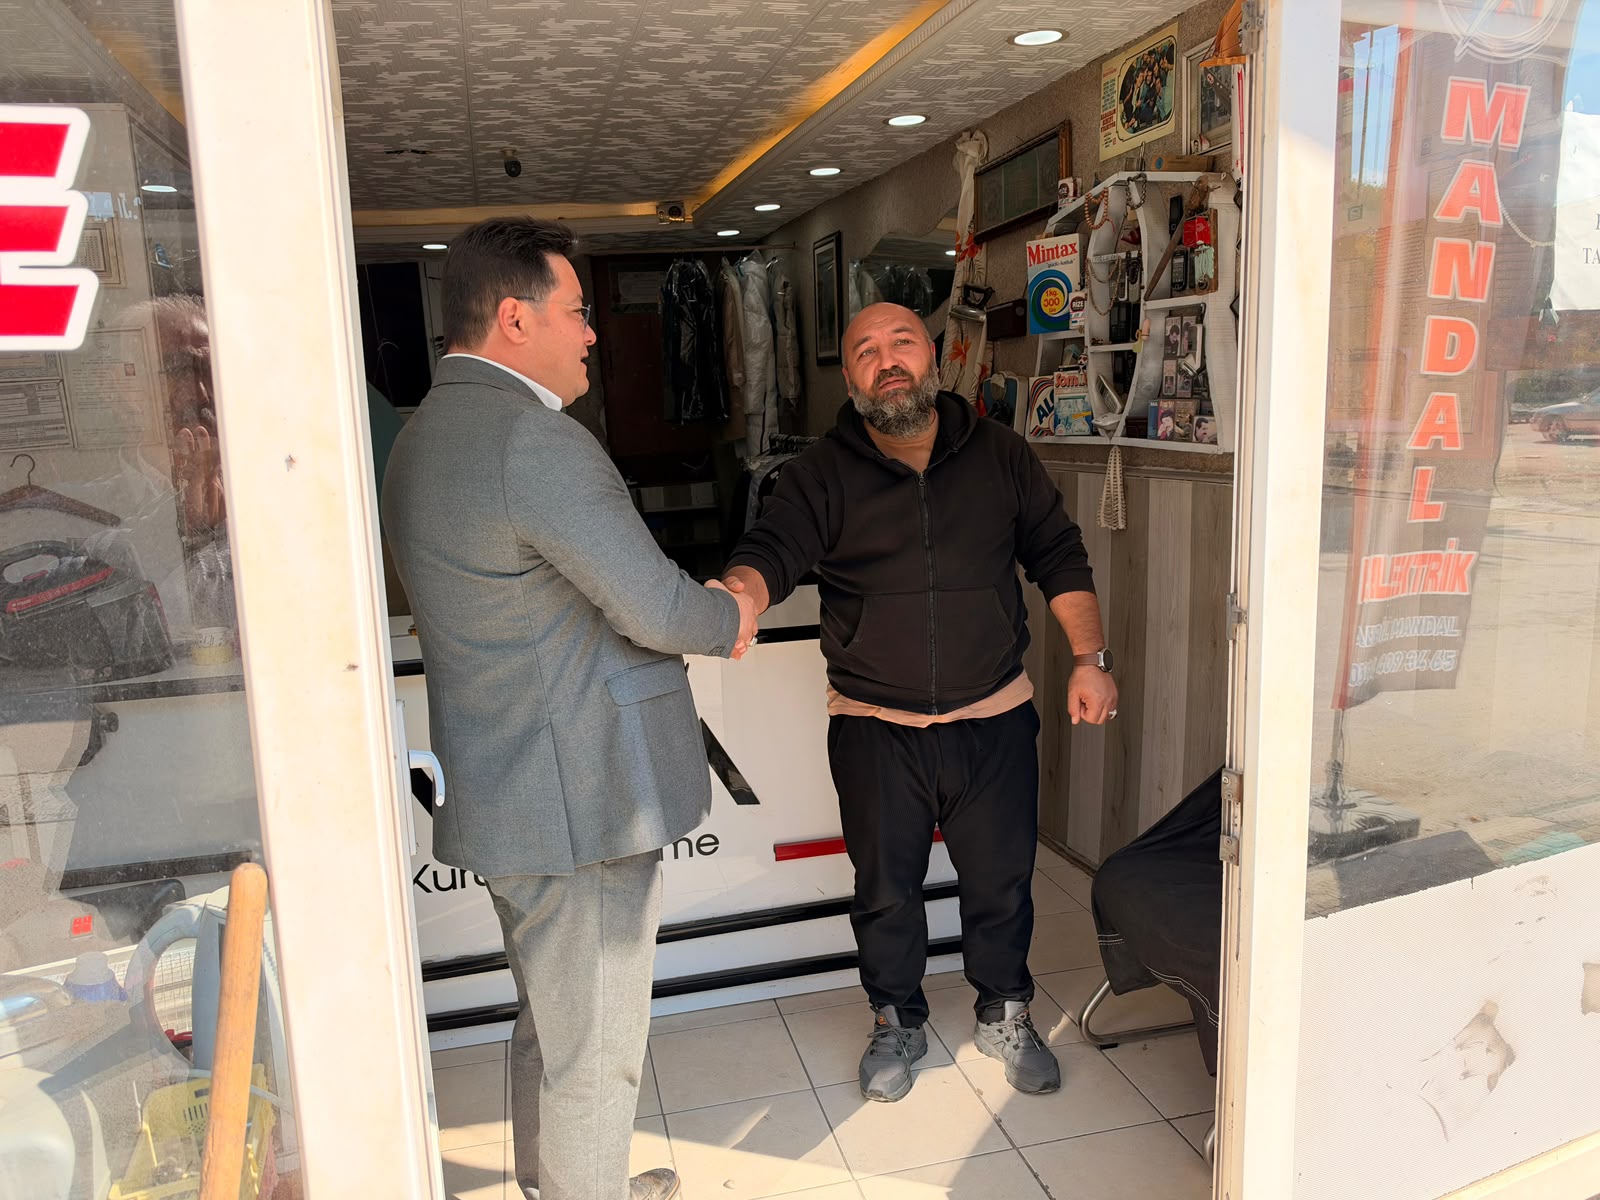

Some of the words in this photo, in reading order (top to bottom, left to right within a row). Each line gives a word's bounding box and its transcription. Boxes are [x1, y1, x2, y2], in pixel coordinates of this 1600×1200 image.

[1027, 242, 1078, 267] Mintax
[1043, 298, 1060, 307] 300
[1406, 76, 1532, 523] MANDAL
